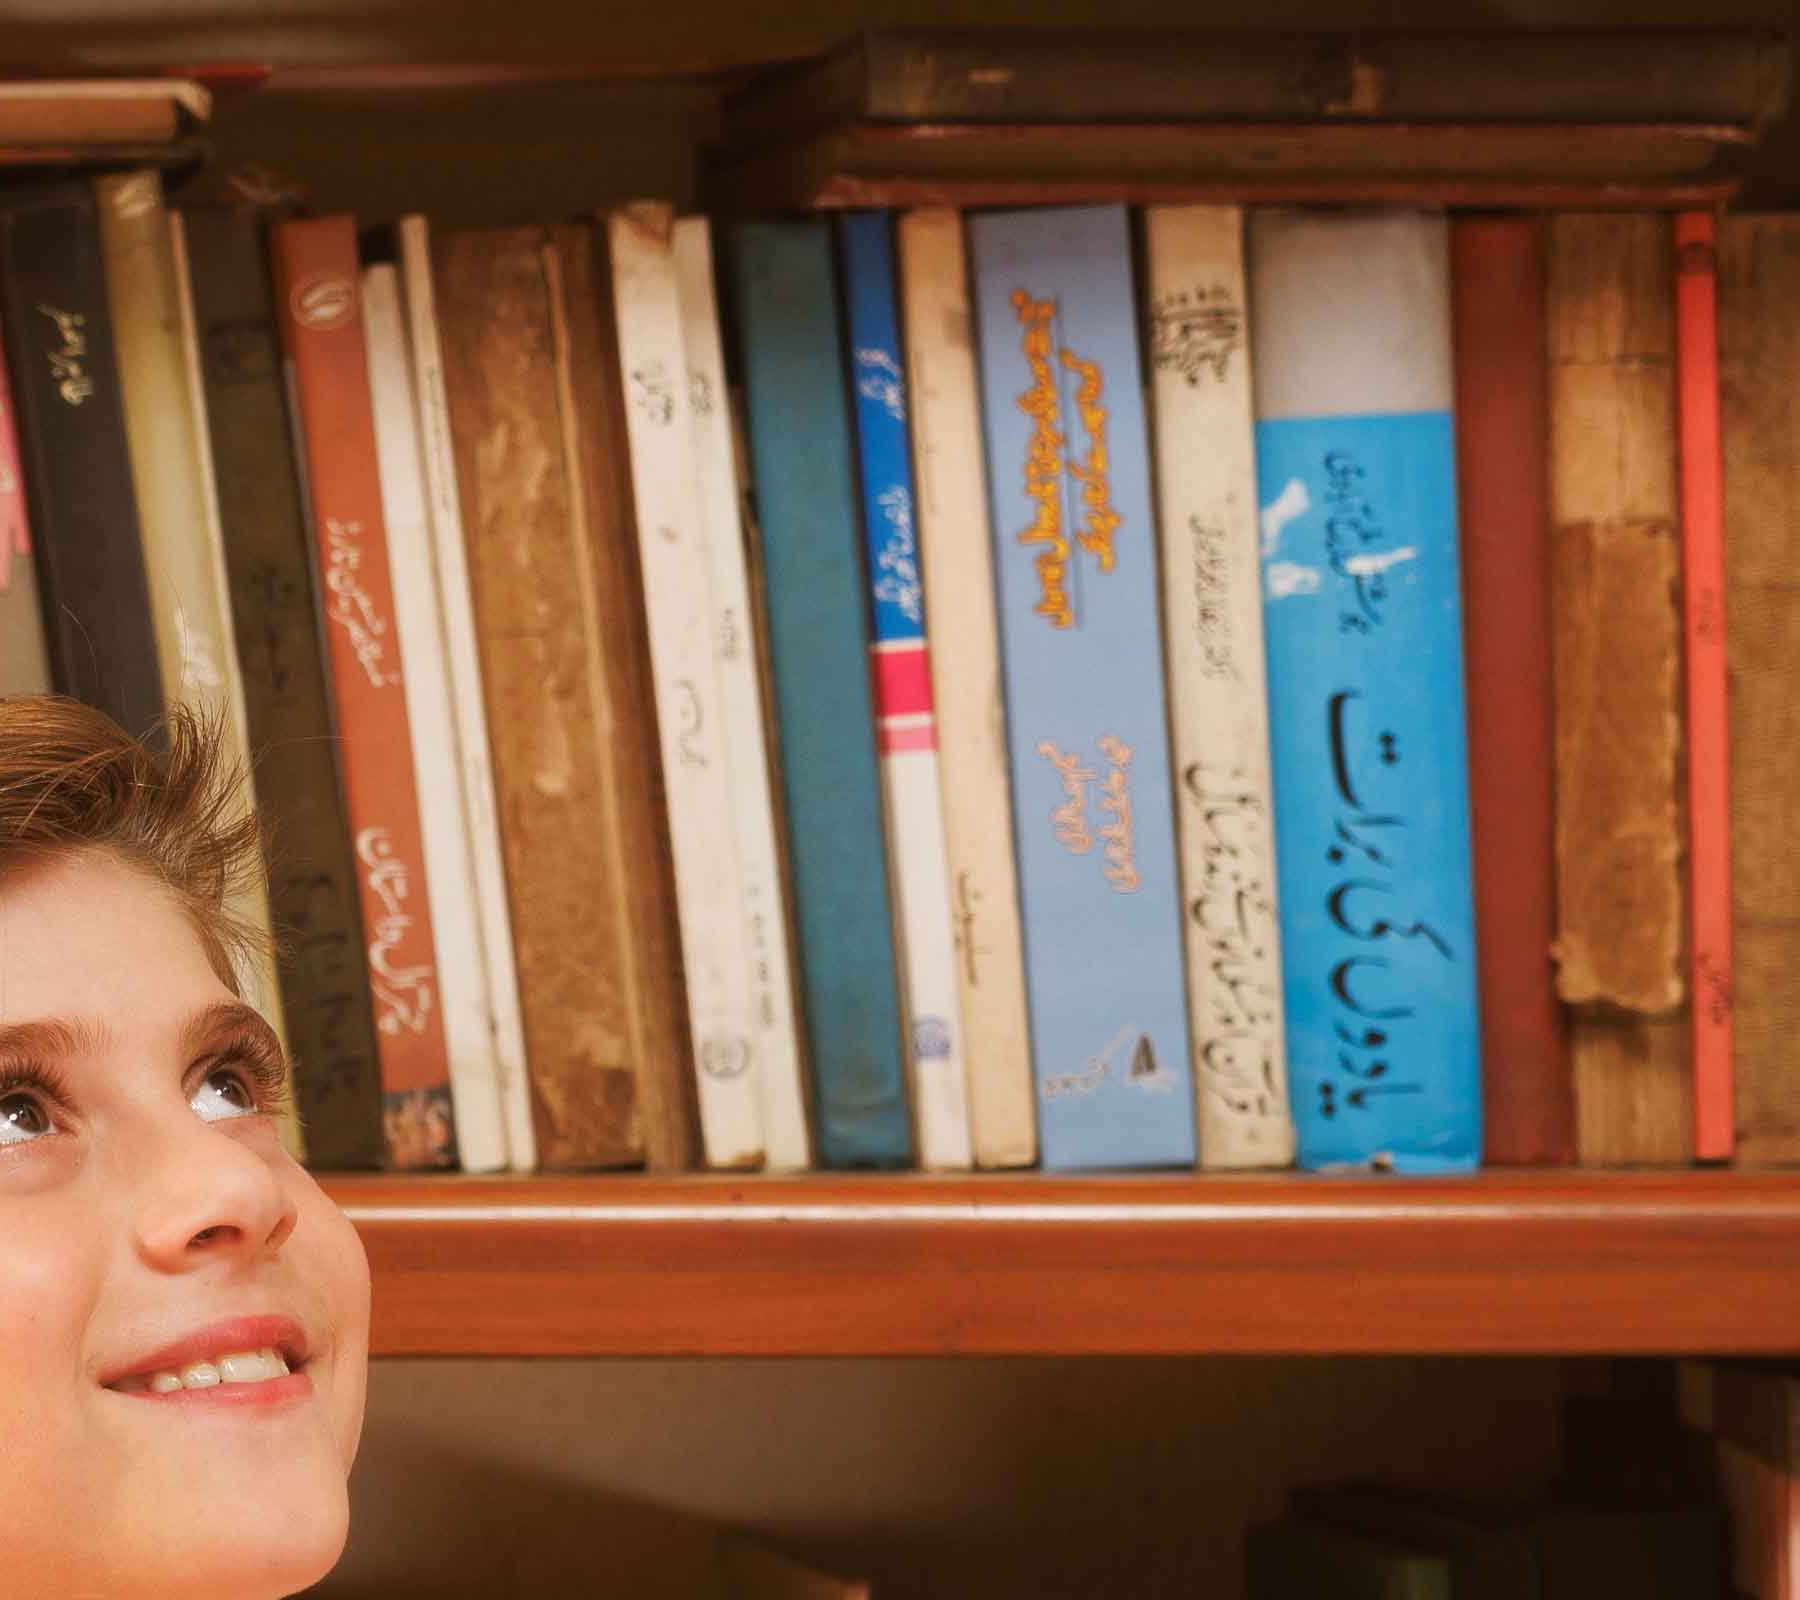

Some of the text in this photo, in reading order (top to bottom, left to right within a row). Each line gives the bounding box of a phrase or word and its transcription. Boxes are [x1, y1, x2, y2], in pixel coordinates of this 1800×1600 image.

[1318, 688, 1458, 1118] یادوں کی برات
